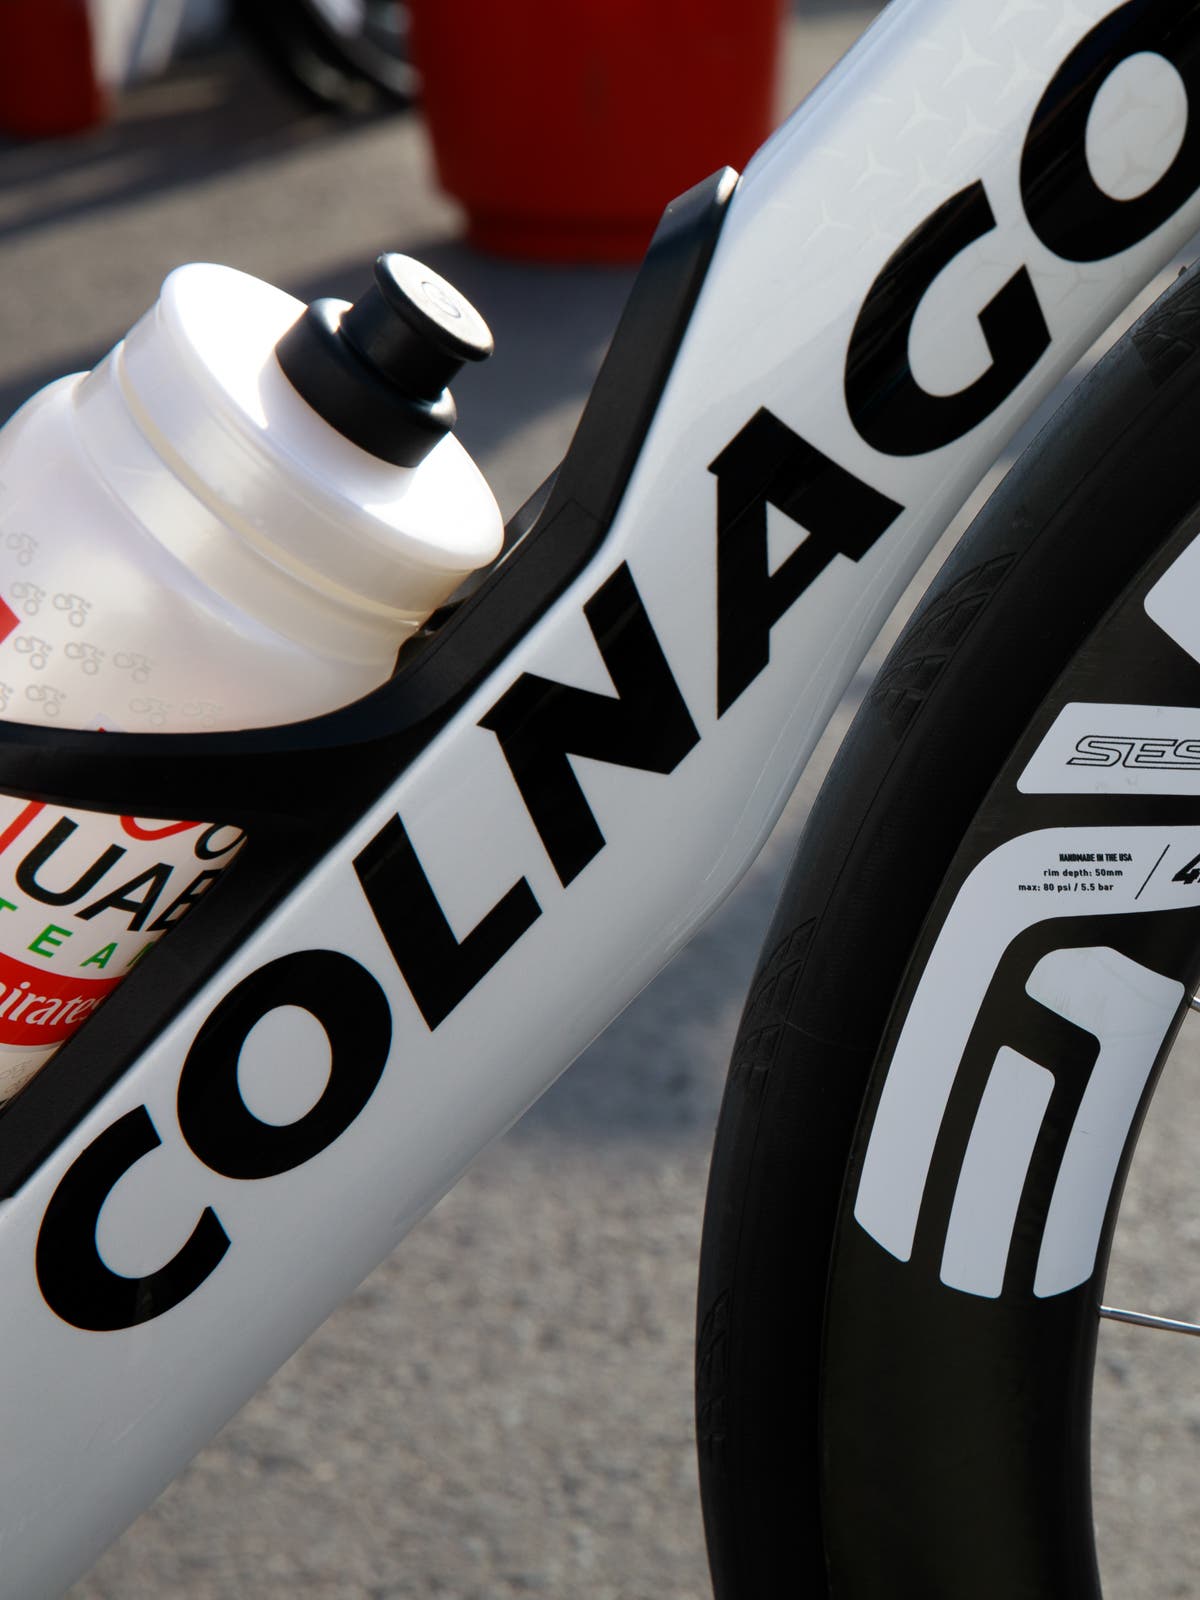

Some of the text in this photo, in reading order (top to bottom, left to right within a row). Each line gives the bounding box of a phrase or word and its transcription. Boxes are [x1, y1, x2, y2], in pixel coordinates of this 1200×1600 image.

[1059, 853, 1133, 862] HANDMADE IN THE USA
[1043, 868, 1124, 879] rim depth: 50mm
[1018, 882, 1114, 894] max: 80 psi / 5.5 bar
[0, 896, 156, 969] EA
